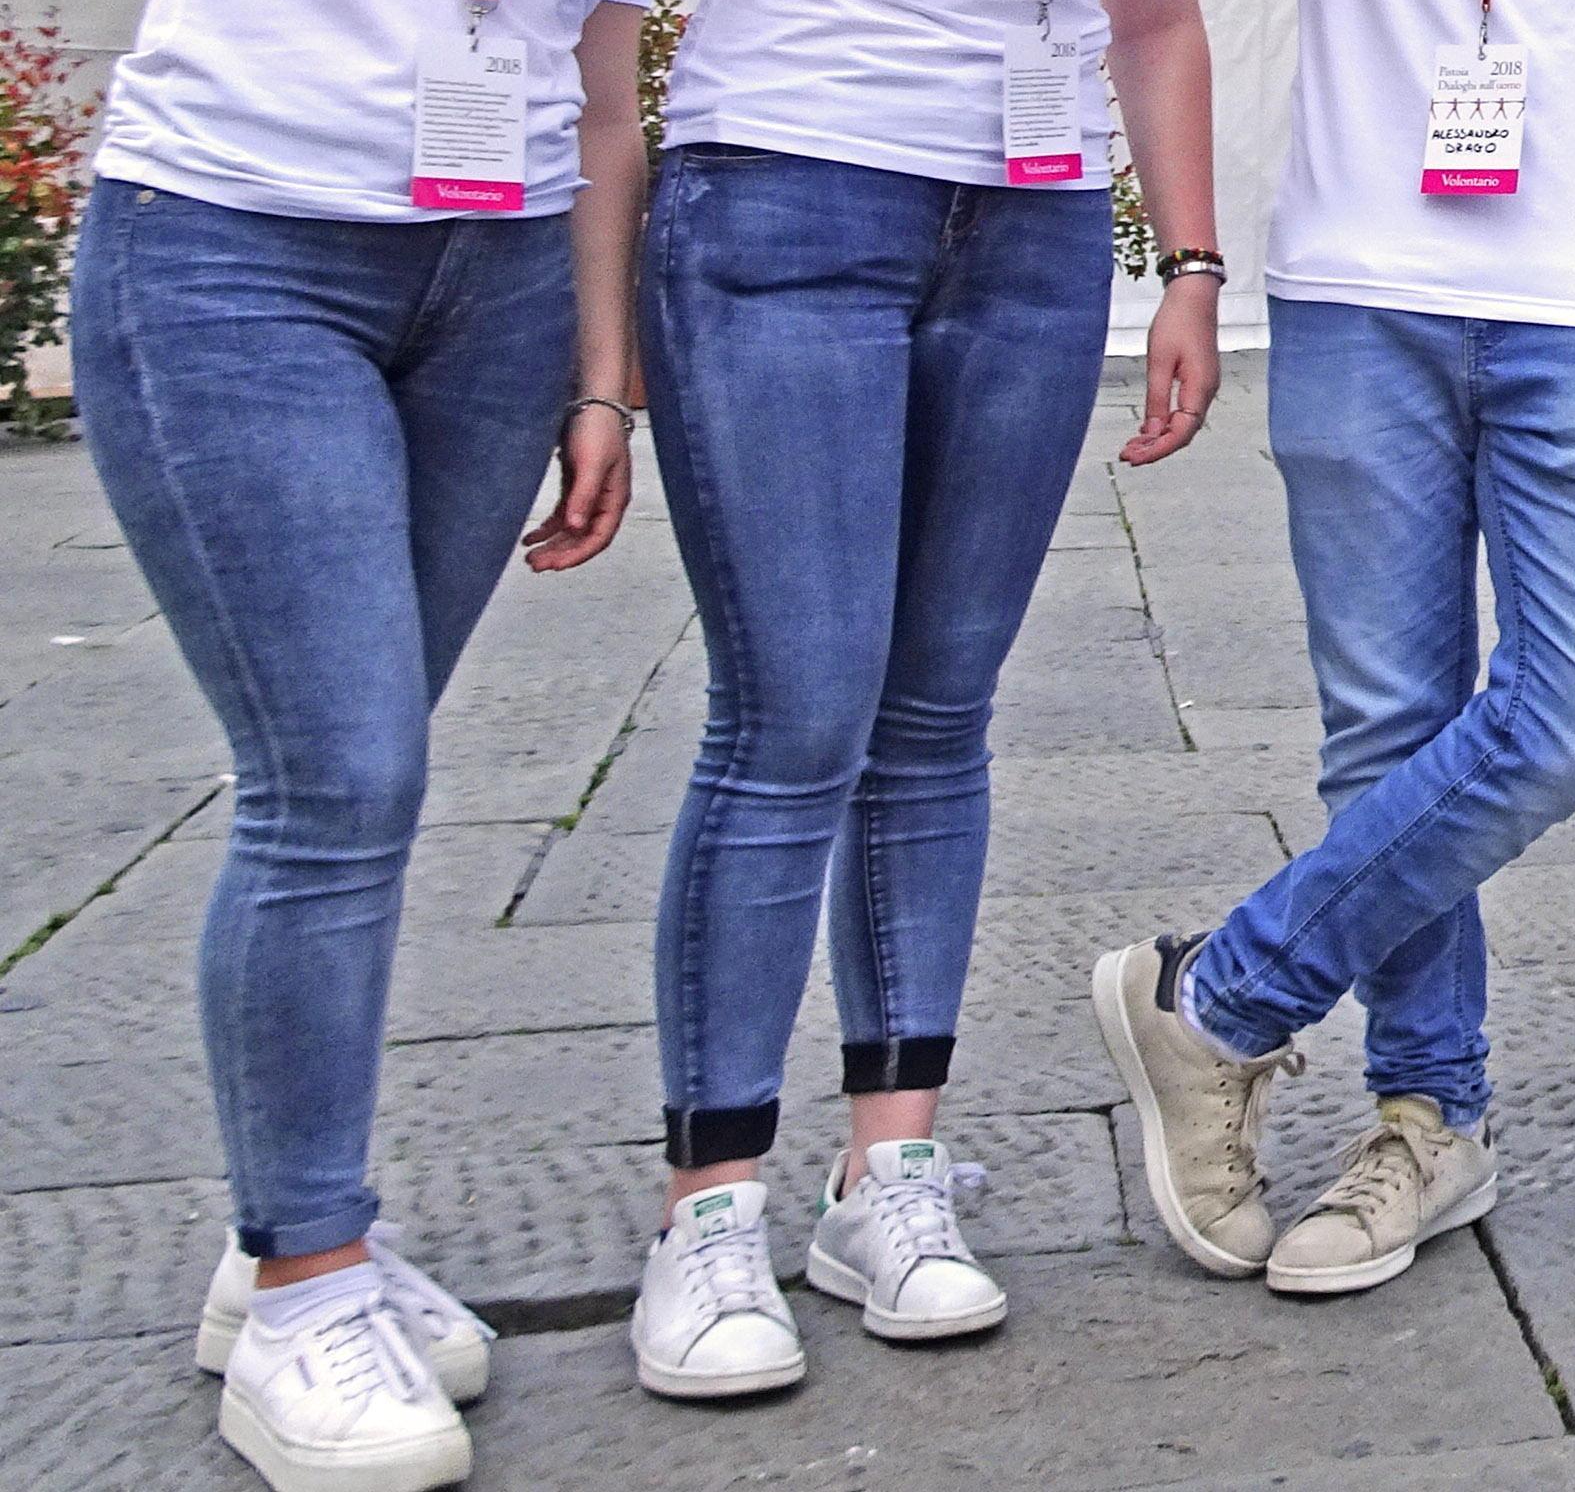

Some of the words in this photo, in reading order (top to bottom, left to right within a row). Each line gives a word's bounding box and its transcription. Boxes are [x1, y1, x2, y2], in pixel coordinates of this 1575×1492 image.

[1051, 43, 1076, 57] 2018
[485, 57, 521, 75] 2018
[1439, 66, 1469, 77] Pistoia
[1490, 61, 1522, 76] 2018
[1438, 80, 1477, 92] Dialoghi
[1432, 128, 1510, 139] ALESSANDRO
[1445, 142, 1497, 153] DRAGO
[1442, 174, 1499, 187] Volontario
